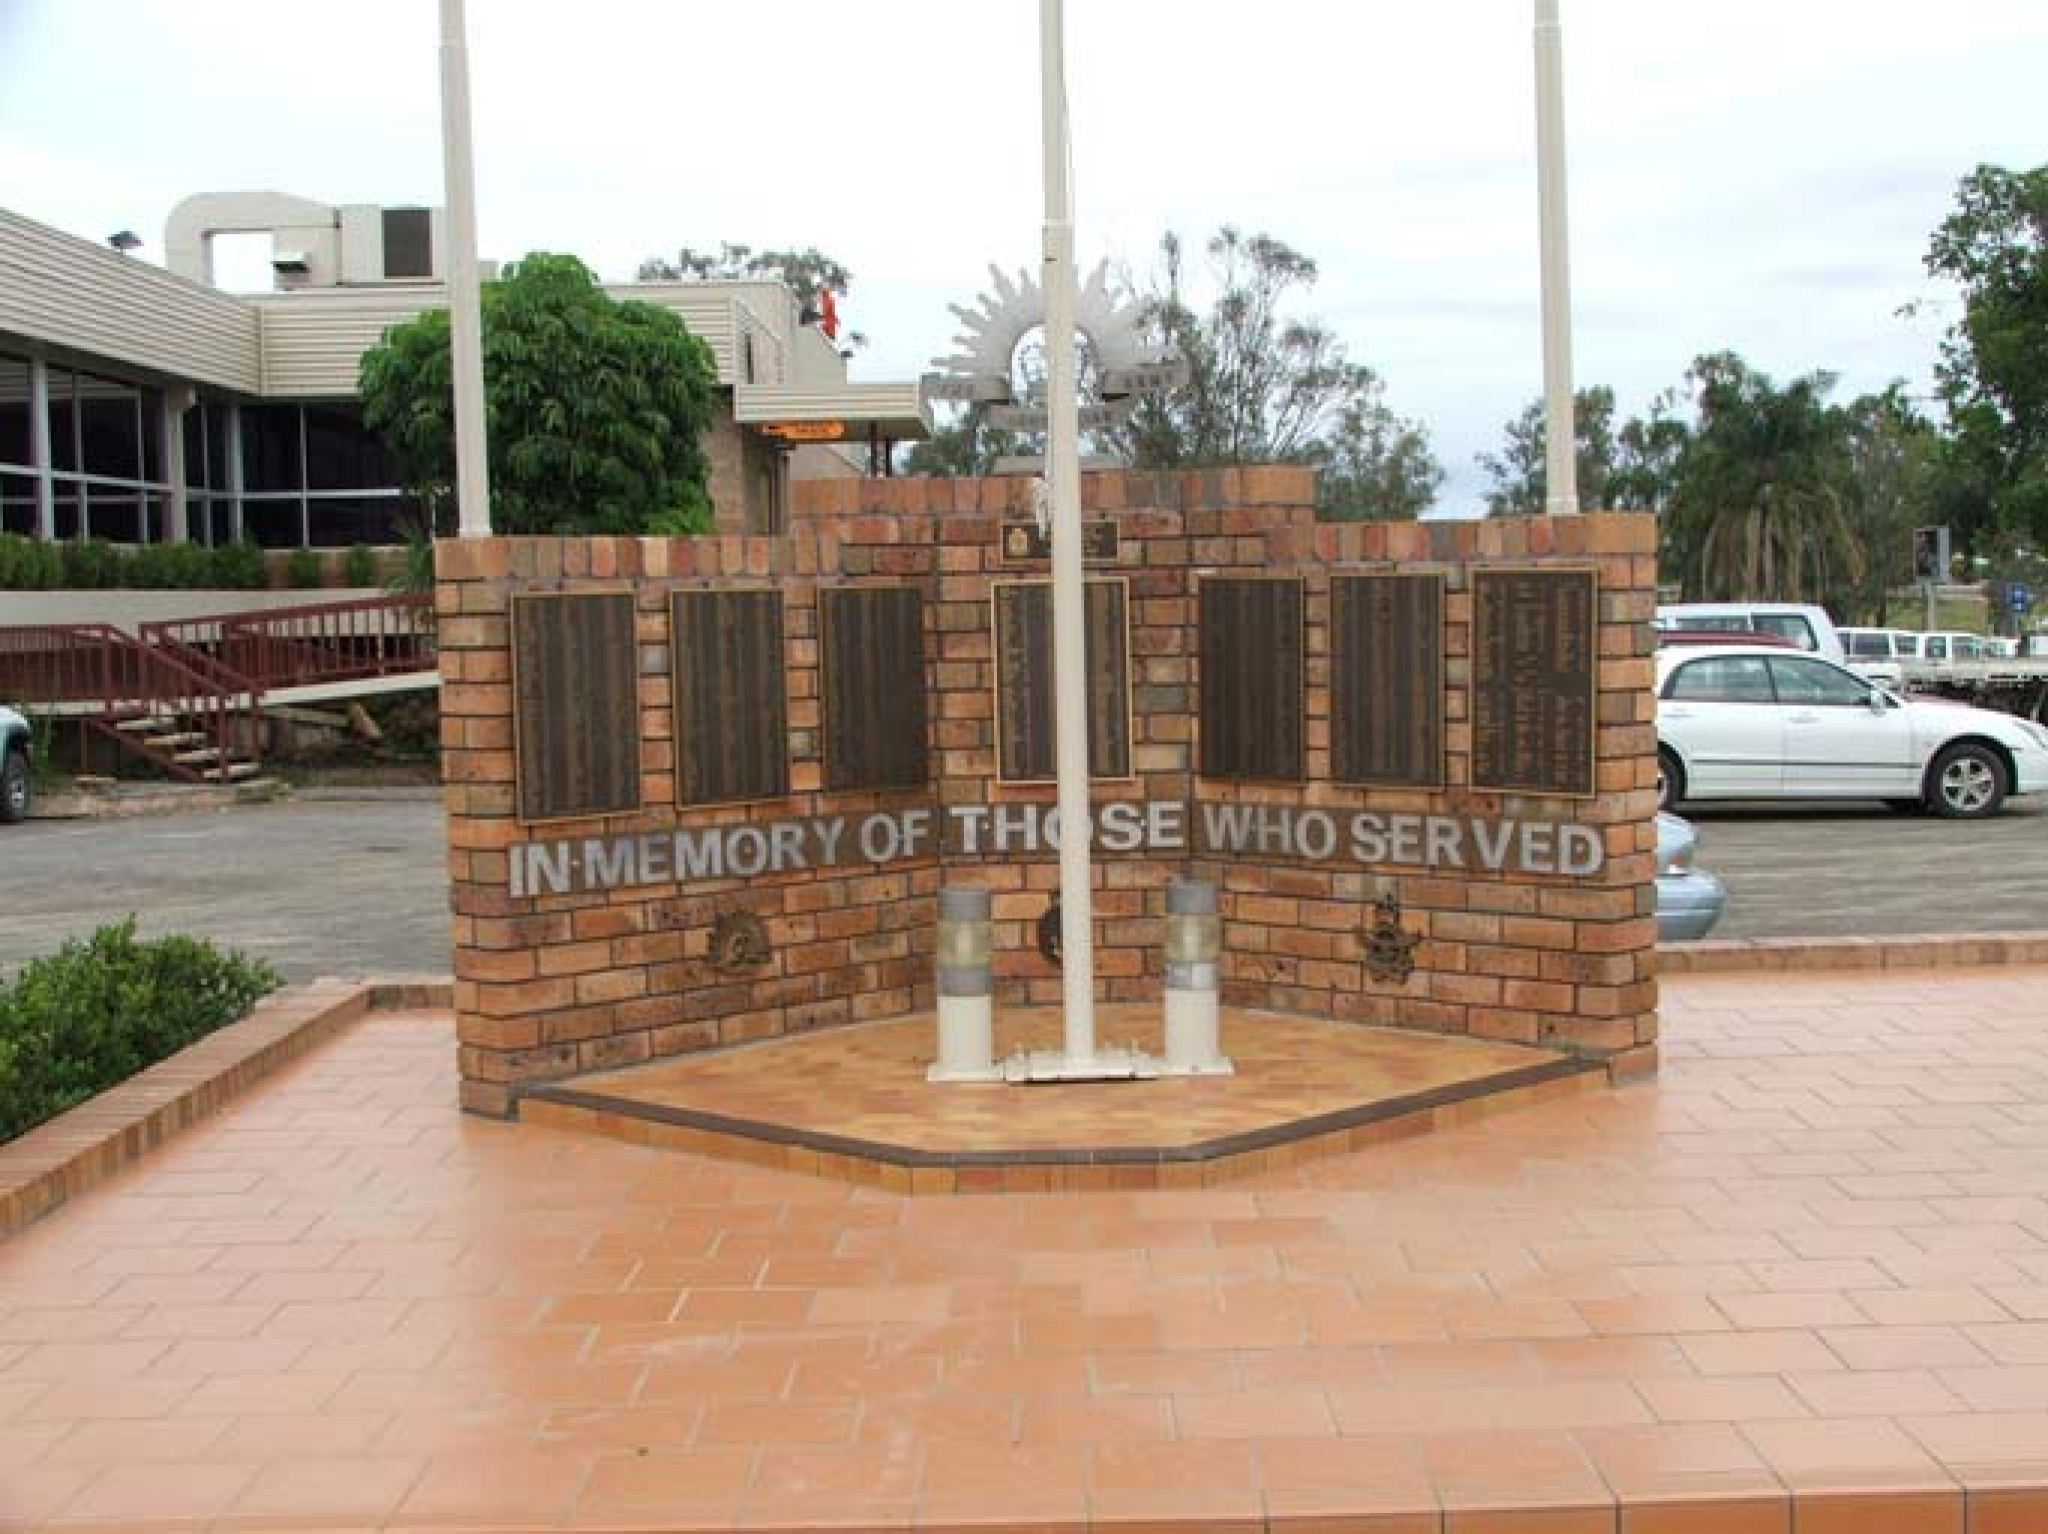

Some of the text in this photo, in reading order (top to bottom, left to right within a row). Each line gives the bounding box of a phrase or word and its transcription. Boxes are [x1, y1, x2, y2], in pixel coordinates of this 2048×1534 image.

[509, 841, 571, 898] IN
[583, 816, 845, 890] MEMORY
[861, 809, 931, 862] OF
[1203, 803, 1337, 859] WHO
[1350, 812, 1603, 875] SERVED
